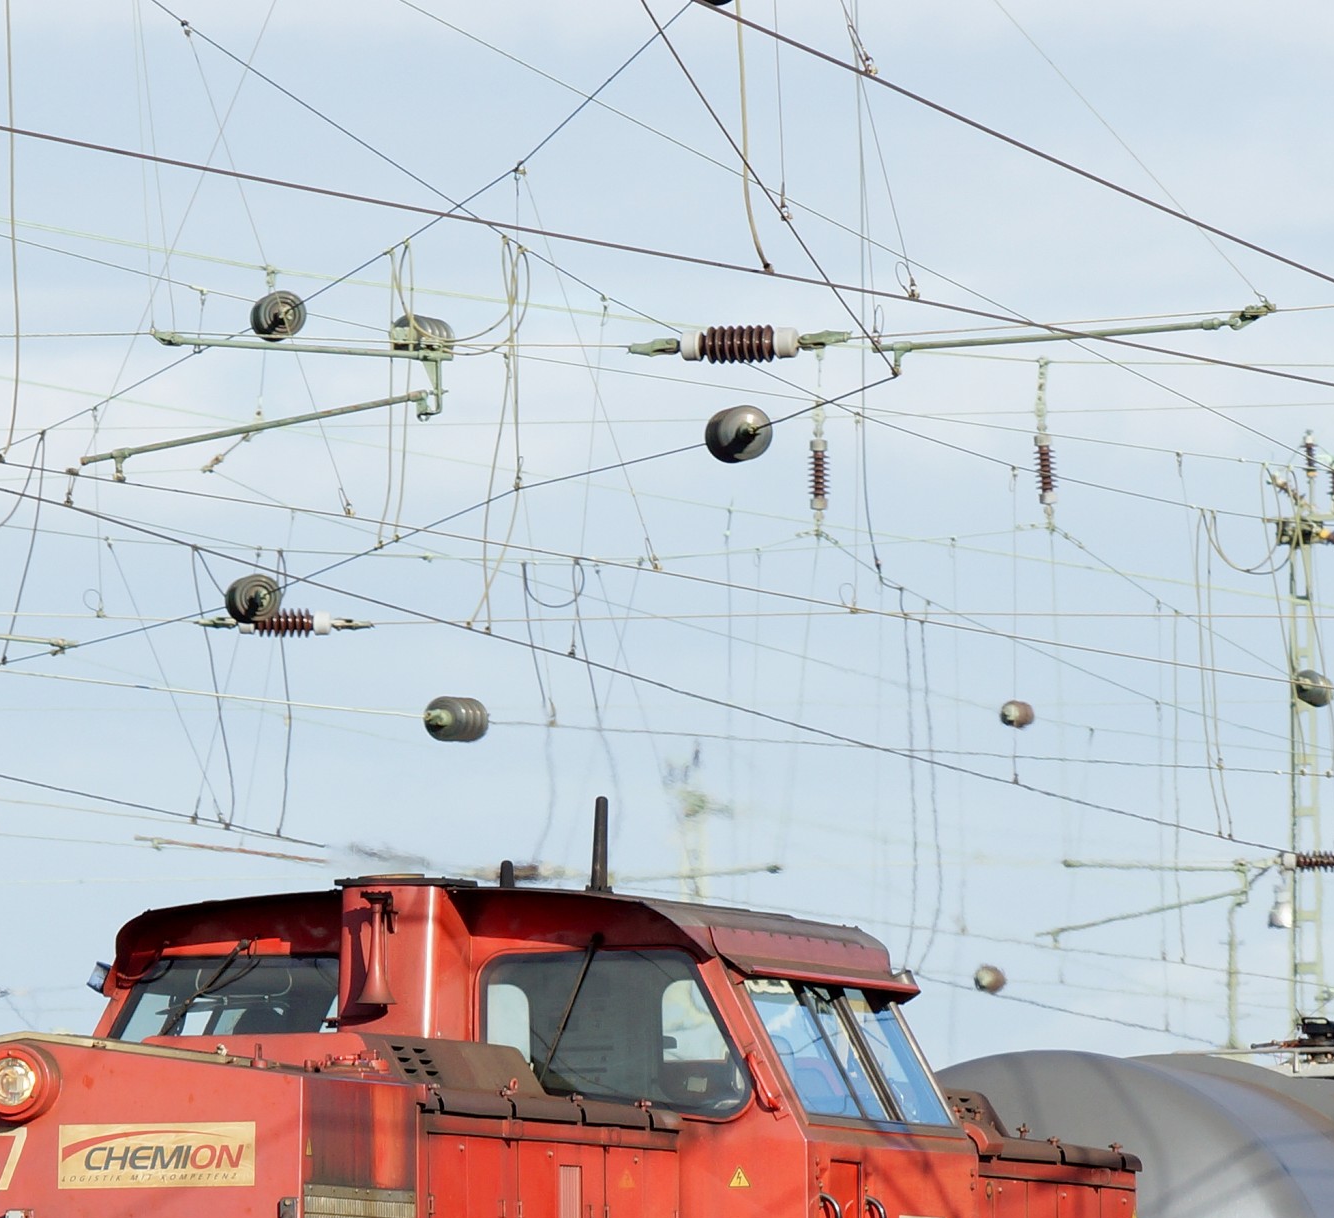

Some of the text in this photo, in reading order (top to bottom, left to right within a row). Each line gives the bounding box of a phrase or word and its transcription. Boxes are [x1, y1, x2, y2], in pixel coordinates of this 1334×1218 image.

[84, 1144, 244, 1171] CHEMION
[130, 1173, 152, 1181] MIT
[160, 1172, 238, 1182] KOMPETENZ
